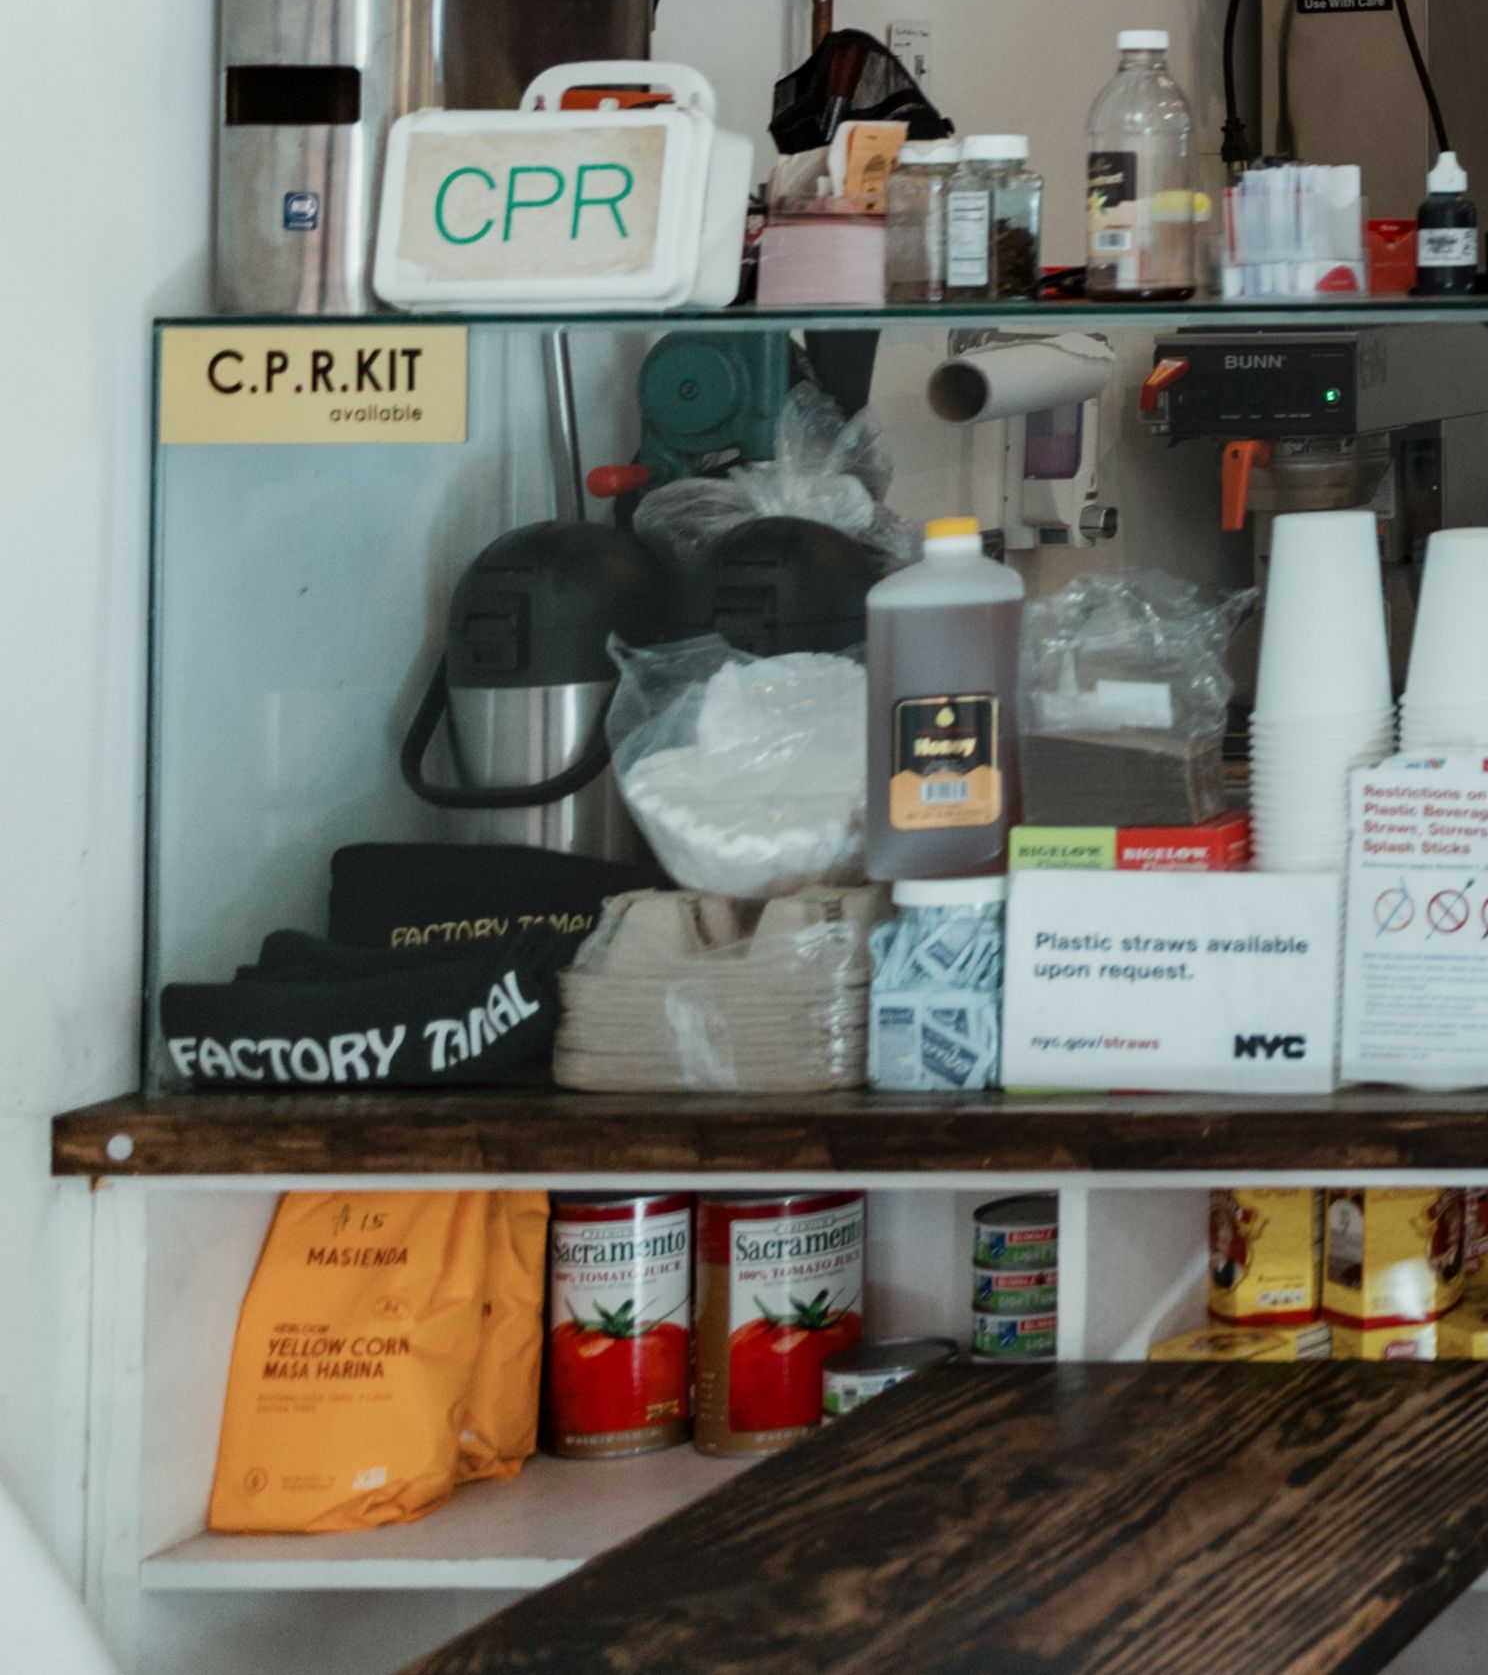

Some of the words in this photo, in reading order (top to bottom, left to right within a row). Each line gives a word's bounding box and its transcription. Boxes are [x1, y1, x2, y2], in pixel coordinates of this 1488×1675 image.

[1304, 0, 1327, 9] Use
[1329, 0, 1355, 8] With
[434, 164, 634, 246] CPR
[1224, 354, 1284, 370] BUNN
[329, 404, 422, 424] available
[1035, 933, 1112, 952] Plastic
[1122, 934, 1197, 953] straws
[1206, 934, 1309, 955] available
[1034, 963, 1090, 980] upon
[1100, 962, 1194, 981] request.
[168, 1025, 406, 1082] FACTORY
[1234, 1034, 1306, 1060] NYC
[306, 1247, 408, 1266] MASIENDA
[268, 1337, 346, 1357] YELLOW
[351, 1337, 410, 1357] CORN
[263, 1361, 309, 1379] MASA
[316, 1361, 384, 1379] HARINA
